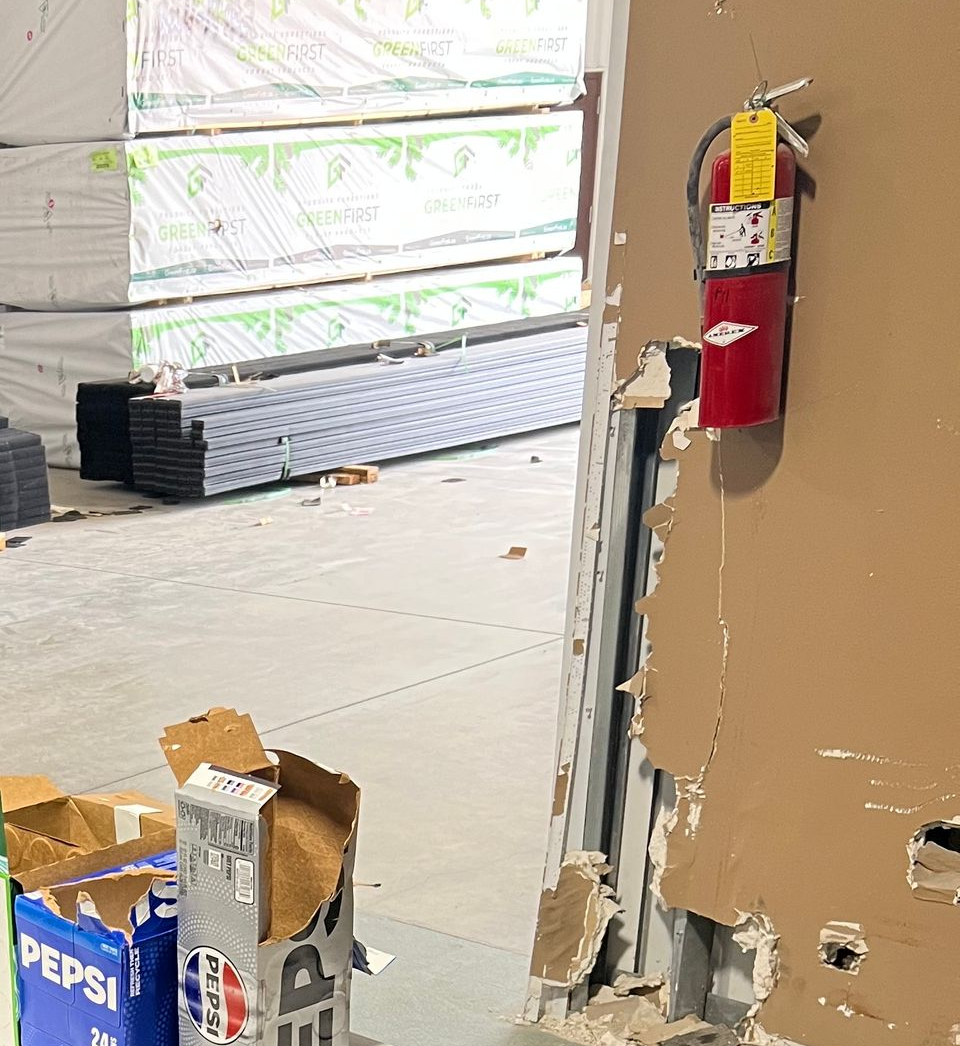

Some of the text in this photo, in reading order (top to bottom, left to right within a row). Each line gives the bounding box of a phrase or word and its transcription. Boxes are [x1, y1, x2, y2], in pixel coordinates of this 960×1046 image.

[424, 193, 501, 214] GREENFIRST
[714, 204, 762, 212] INSTRUCTIONS
[296, 206, 380, 229] GREENFIRST
[21, 932, 117, 1012] PEPSI
[205, 953, 219, 1038] PEPSI
